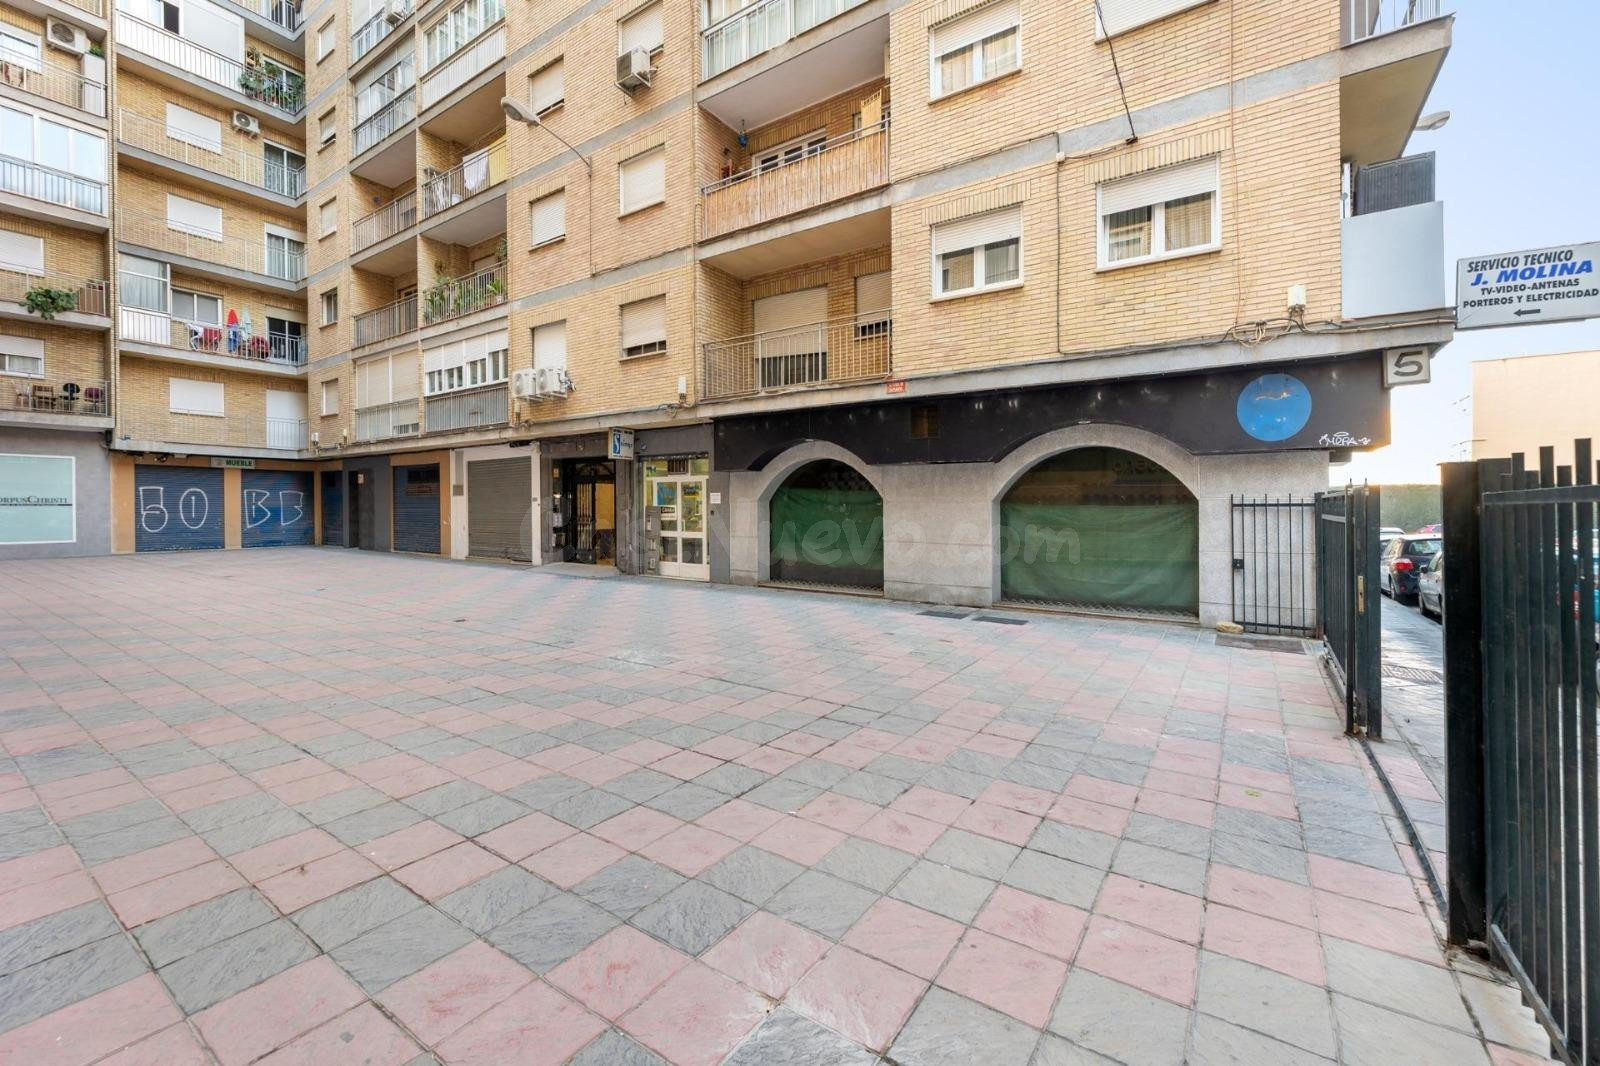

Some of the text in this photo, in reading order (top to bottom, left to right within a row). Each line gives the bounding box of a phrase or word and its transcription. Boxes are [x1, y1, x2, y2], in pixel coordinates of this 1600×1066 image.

[1467, 249, 1573, 273] SERVICIO TECNICO
[1470, 260, 1593, 286] J. MOLINA
[1463, 288, 1599, 308] PORTEROS Y ELECTRICIDAD
[1393, 351, 1424, 377] 5
